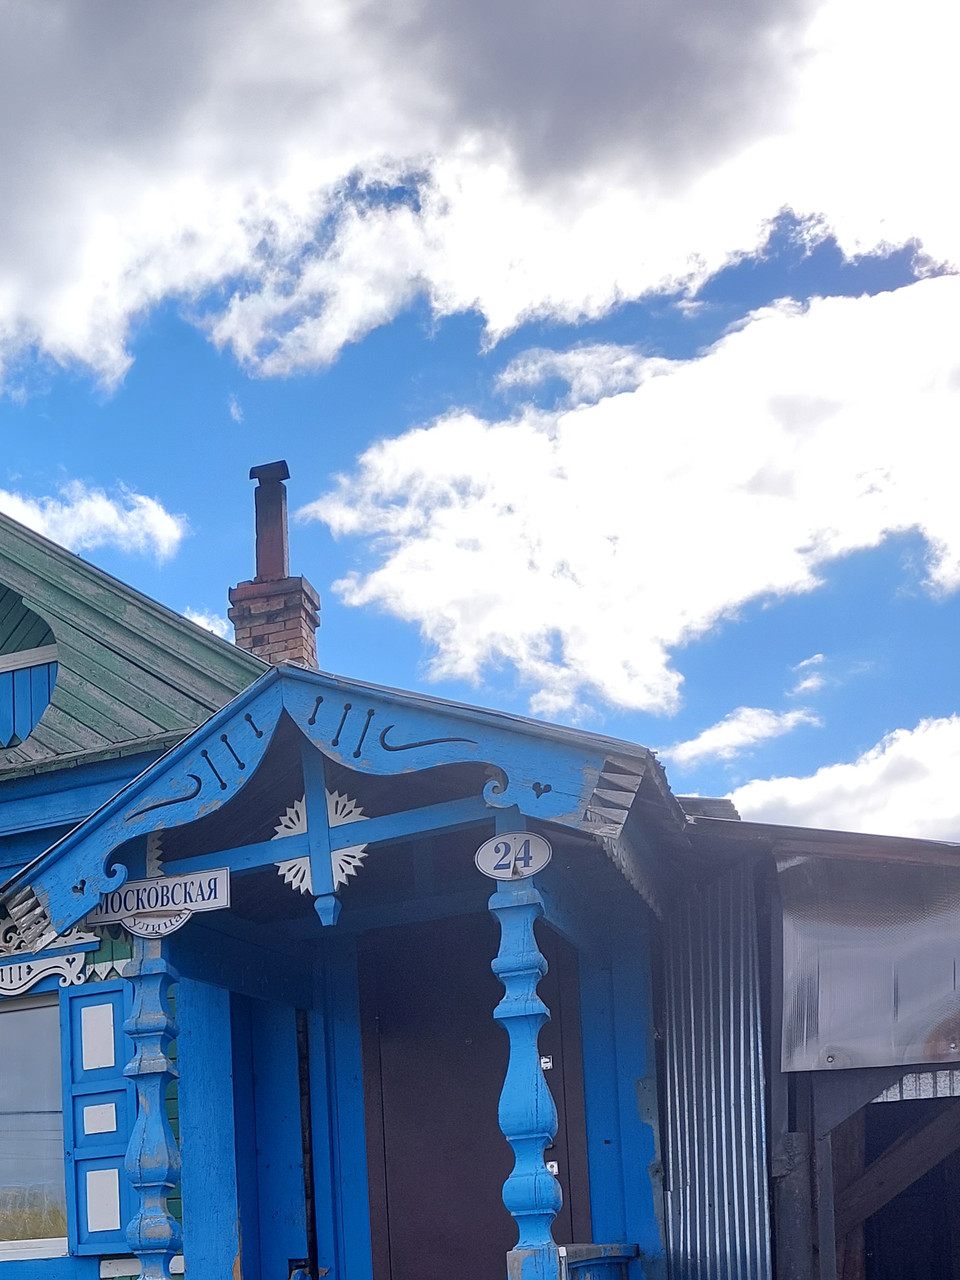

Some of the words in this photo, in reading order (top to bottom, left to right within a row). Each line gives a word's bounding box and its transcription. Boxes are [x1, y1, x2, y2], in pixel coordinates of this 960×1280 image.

[493, 839, 533, 870] 24
[94, 877, 218, 916] МОСКОВСКАЯ
[129, 912, 184, 932] улица
